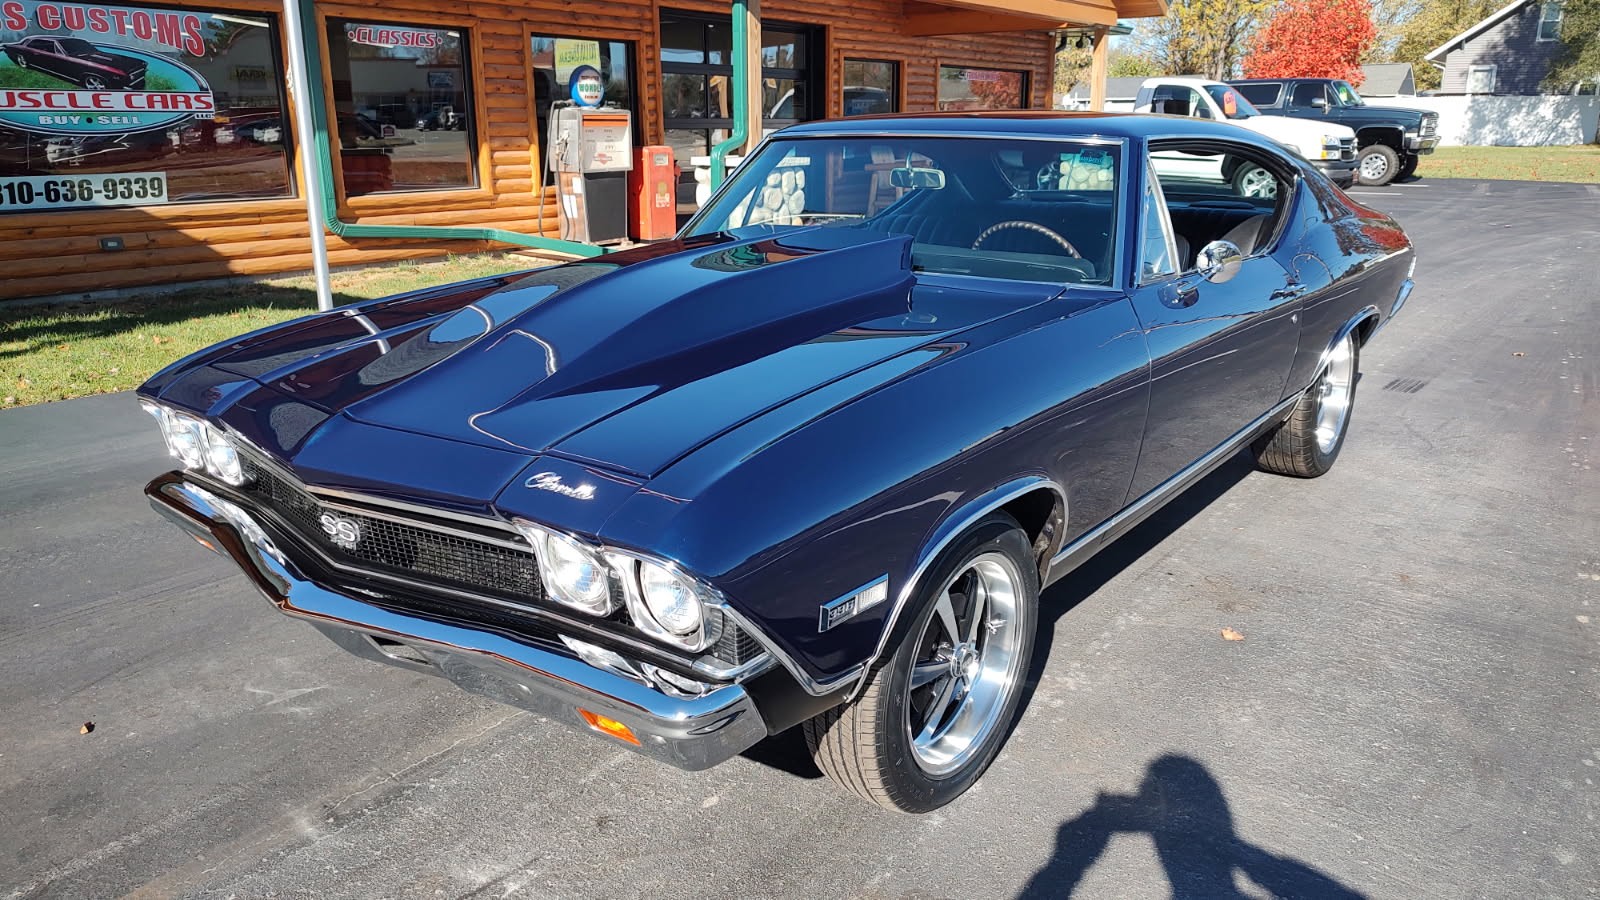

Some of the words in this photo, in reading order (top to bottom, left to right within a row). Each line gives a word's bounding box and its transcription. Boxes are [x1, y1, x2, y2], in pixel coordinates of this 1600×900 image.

[37, 4, 205, 57] CUSTOMS
[356, 27, 436, 48] CLASSICS
[124, 93, 213, 109] CARS
[39, 115, 80, 125] BUY
[98, 115, 142, 125] SELL
[321, 514, 356, 541] SS
